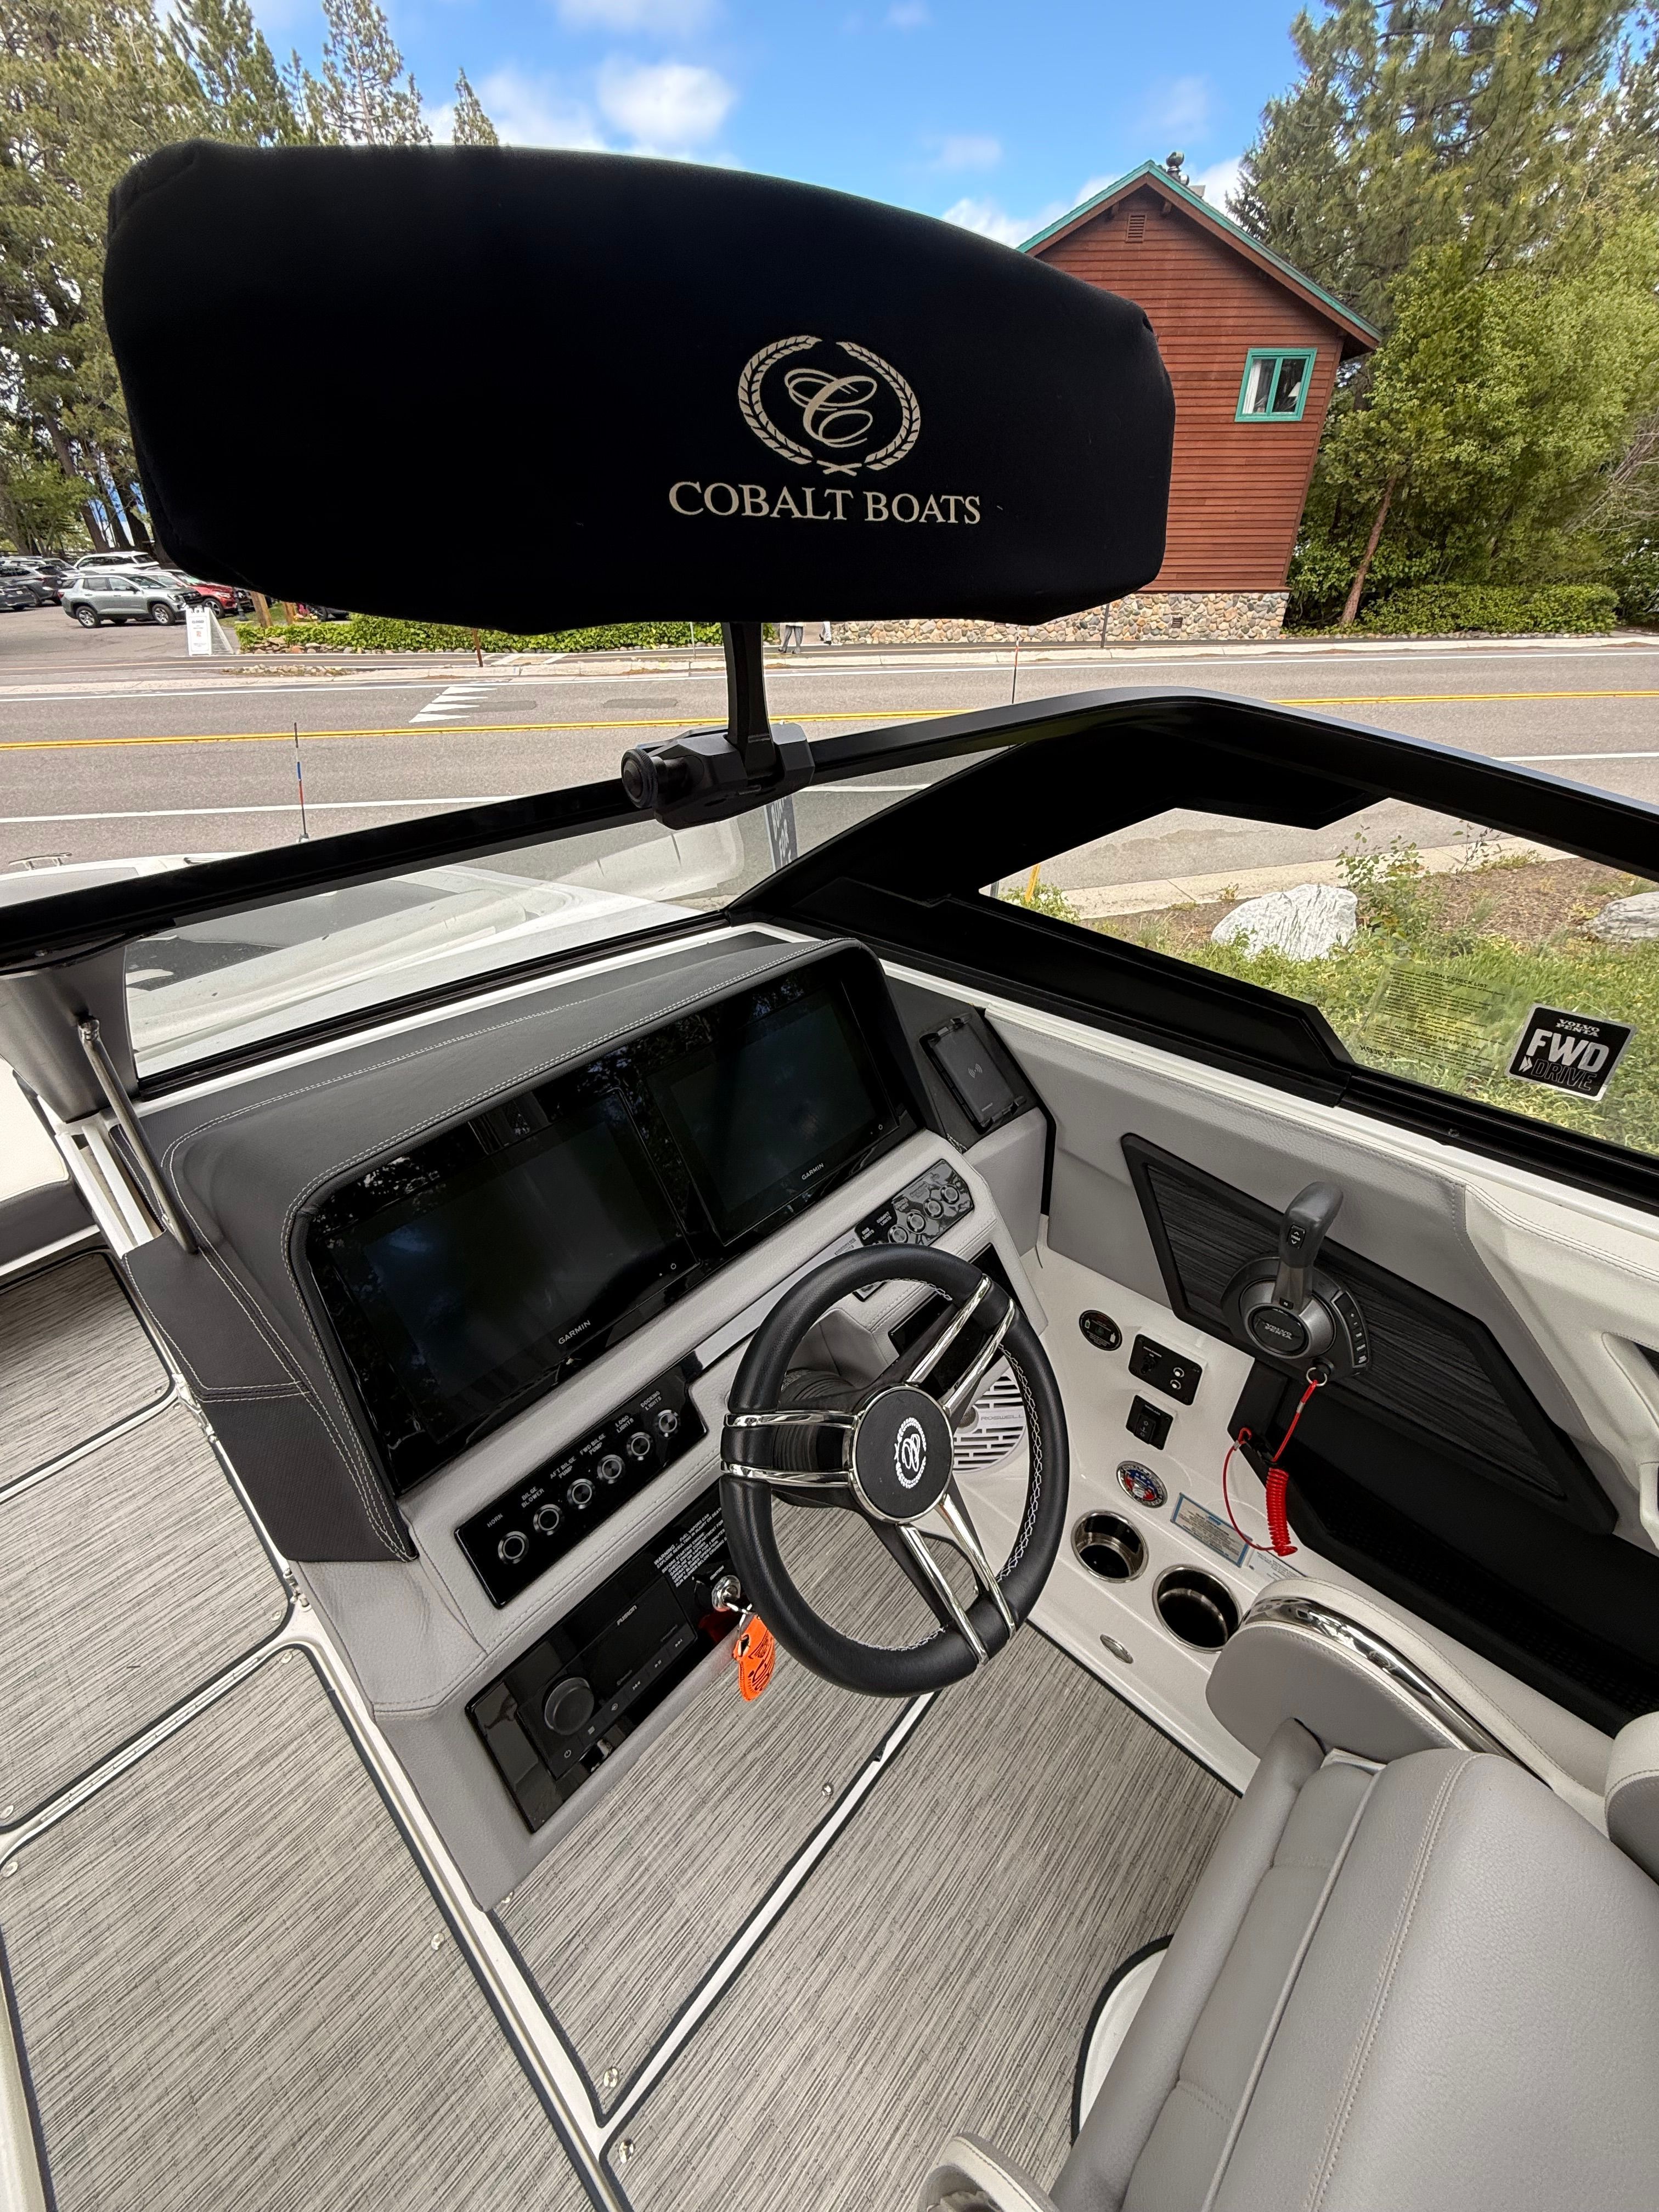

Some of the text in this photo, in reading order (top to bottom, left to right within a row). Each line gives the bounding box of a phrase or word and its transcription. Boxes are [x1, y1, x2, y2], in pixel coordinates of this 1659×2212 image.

[669, 481, 980, 524] COBALT BOATS
[1426, 971, 1450, 980] COBALT
[1555, 1023, 1599, 1037] PENTA
[1559, 1019, 1600, 1032] VOLVO
[1526, 1029, 1609, 1073] FWD
[1531, 1059, 1597, 1091] DRIVE
[802, 1163, 823, 1180] GARMIN
[558, 1319, 590, 1344] GARMIN
[1265, 1326, 1293, 1340] PENTA
[1266, 1323, 1292, 1335] VOLVO
[640, 1391, 660, 1408] DOCKING
[645, 1396, 662, 1410] LIGHTS
[615, 1415, 629, 1427] LOGO
[617, 1418, 634, 1433] LIGHTS
[579, 1433, 606, 1455] FWD BILGE
[589, 1442, 602, 1455] PUMP
[550, 1456, 576, 1479] AFT BILGE
[558, 1465, 572, 1479] PUMP
[521, 1486, 538, 1500] BILGE
[521, 1488, 544, 1508] BLOWER
[487, 1513, 503, 1527] HORN
[654, 1544, 675, 1565] WARNING
